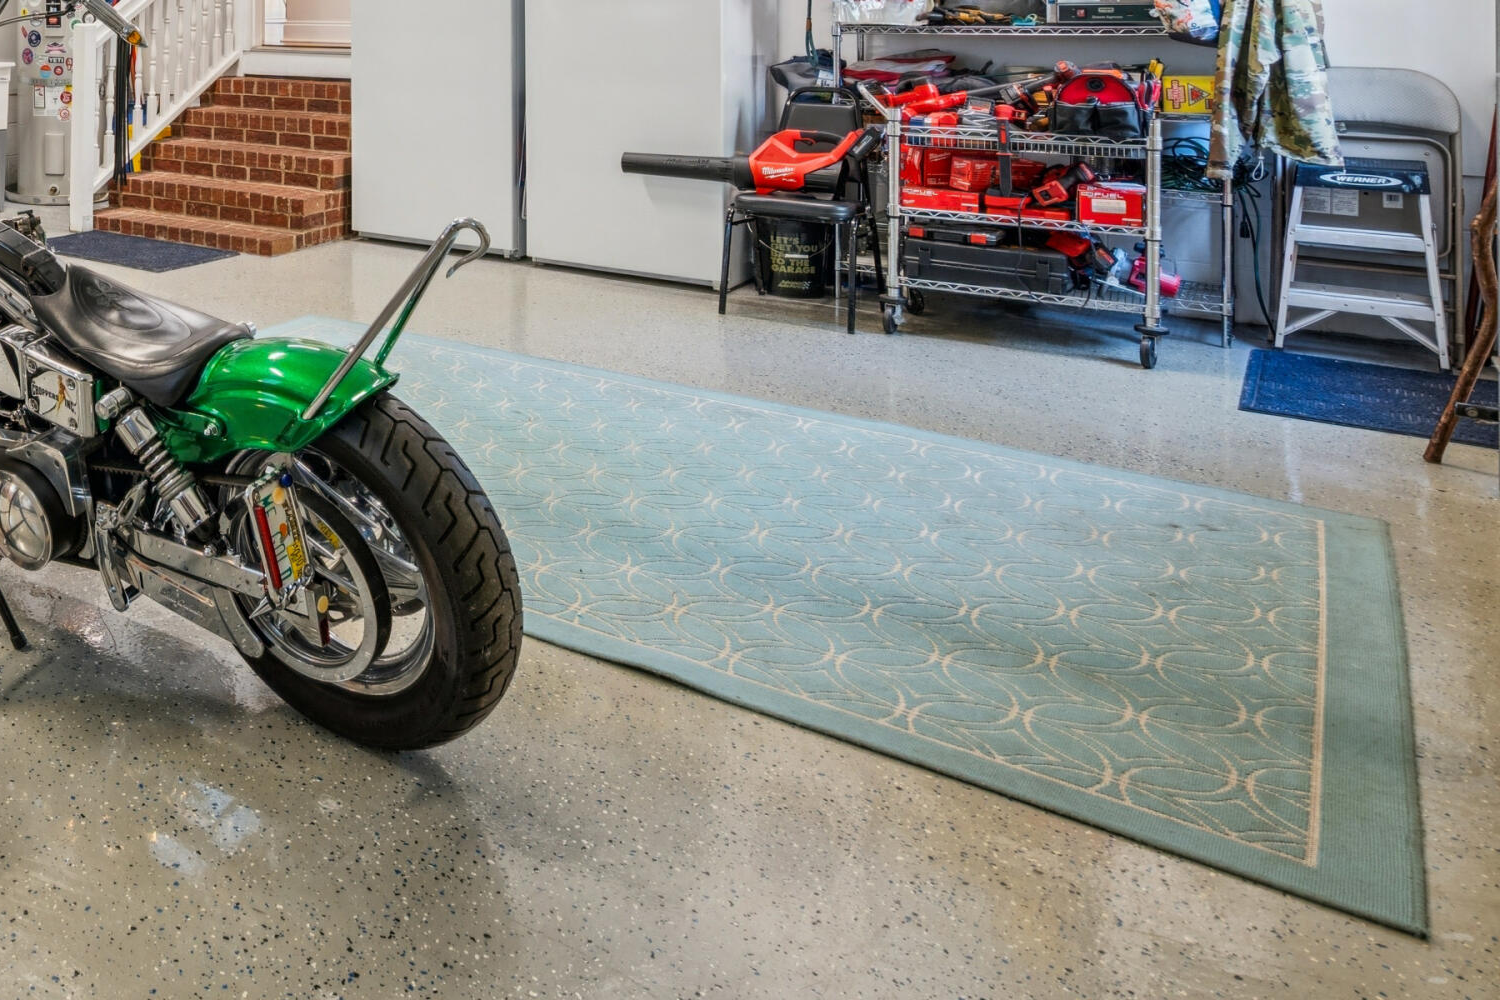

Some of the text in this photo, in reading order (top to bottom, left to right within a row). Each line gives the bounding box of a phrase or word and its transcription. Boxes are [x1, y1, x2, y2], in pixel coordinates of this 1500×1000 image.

[761, 166, 796, 175] Milwaukee
[1335, 175, 1387, 185] WERNER
[1093, 191, 1124, 199] FUEL
[770, 234, 800, 246] LET'S
[798, 244, 818, 253] YOU
[790, 258, 810, 267] THE
[771, 264, 816, 274] GARAGE
[31, 382, 59, 401] CHOPPERS
